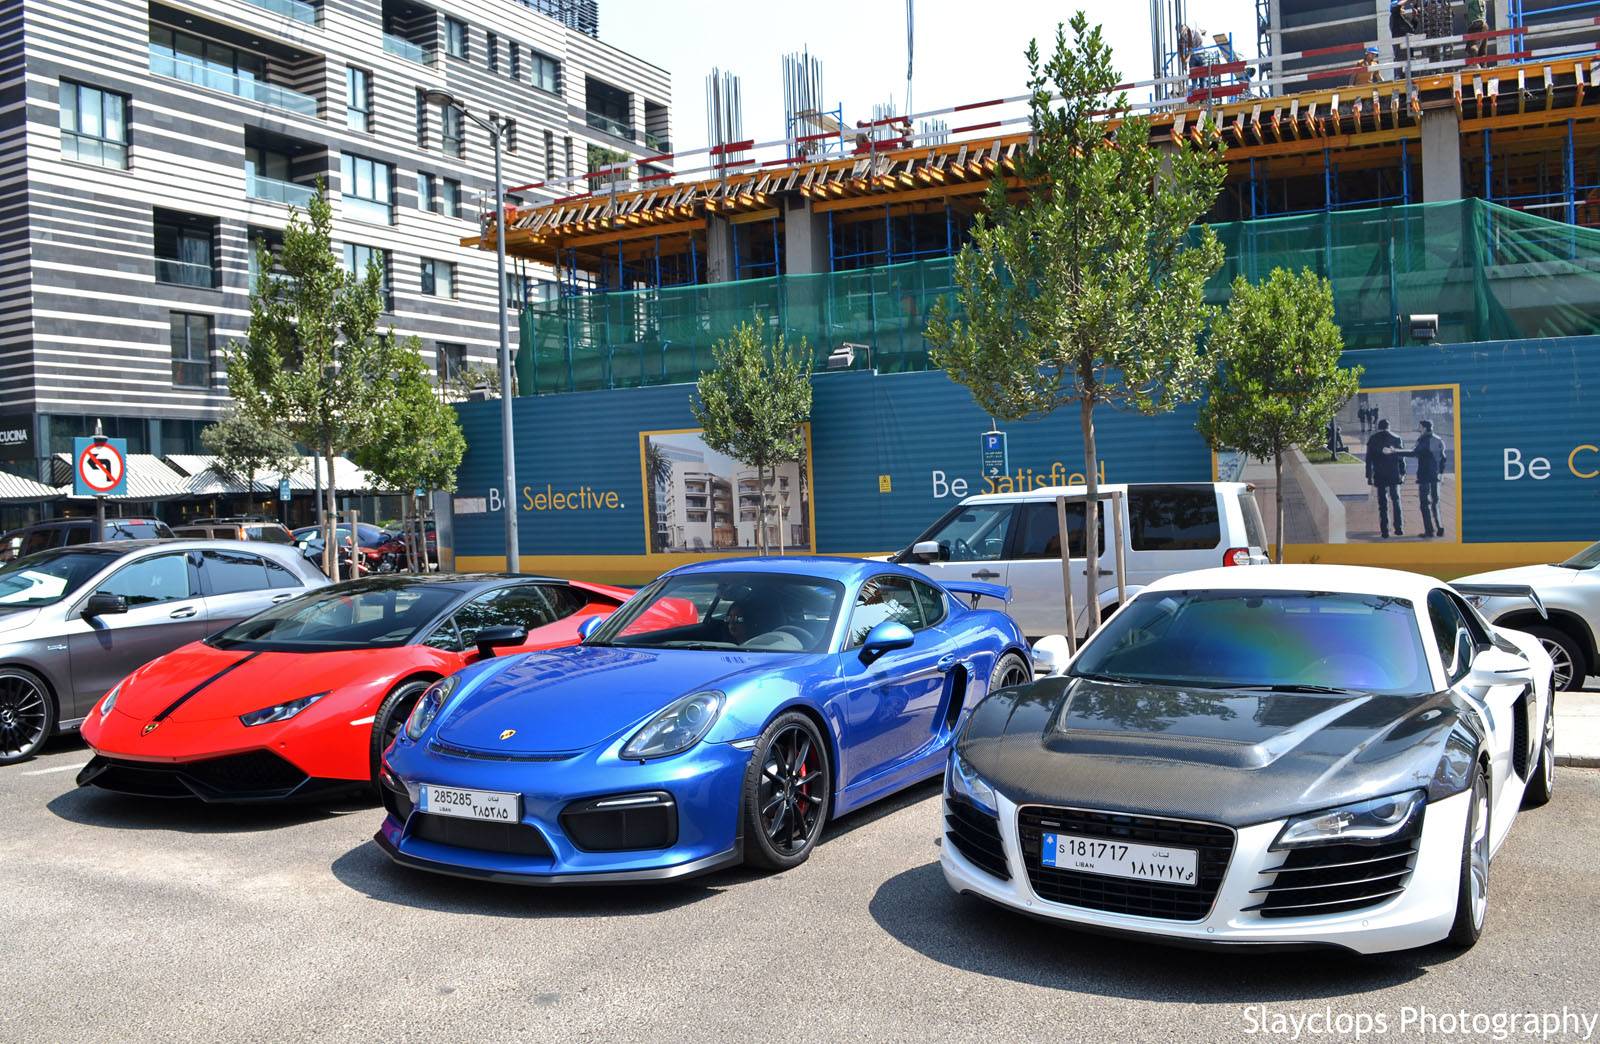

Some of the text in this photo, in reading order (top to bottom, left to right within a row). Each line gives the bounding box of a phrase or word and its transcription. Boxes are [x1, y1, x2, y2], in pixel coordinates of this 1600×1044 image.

[989, 437, 997, 448] P
[1503, 447, 1551, 481] Be
[932, 470, 969, 498] Be
[489, 484, 625, 511] B Selective.
[434, 789, 472, 806] 285285
[472, 805, 508, 819] ٢٨٥٢٨٥
[1059, 840, 1129, 861] S 181717
[1075, 861, 1095, 869] LIBAN
[1131, 861, 1184, 880] ١٨١٧١٧
